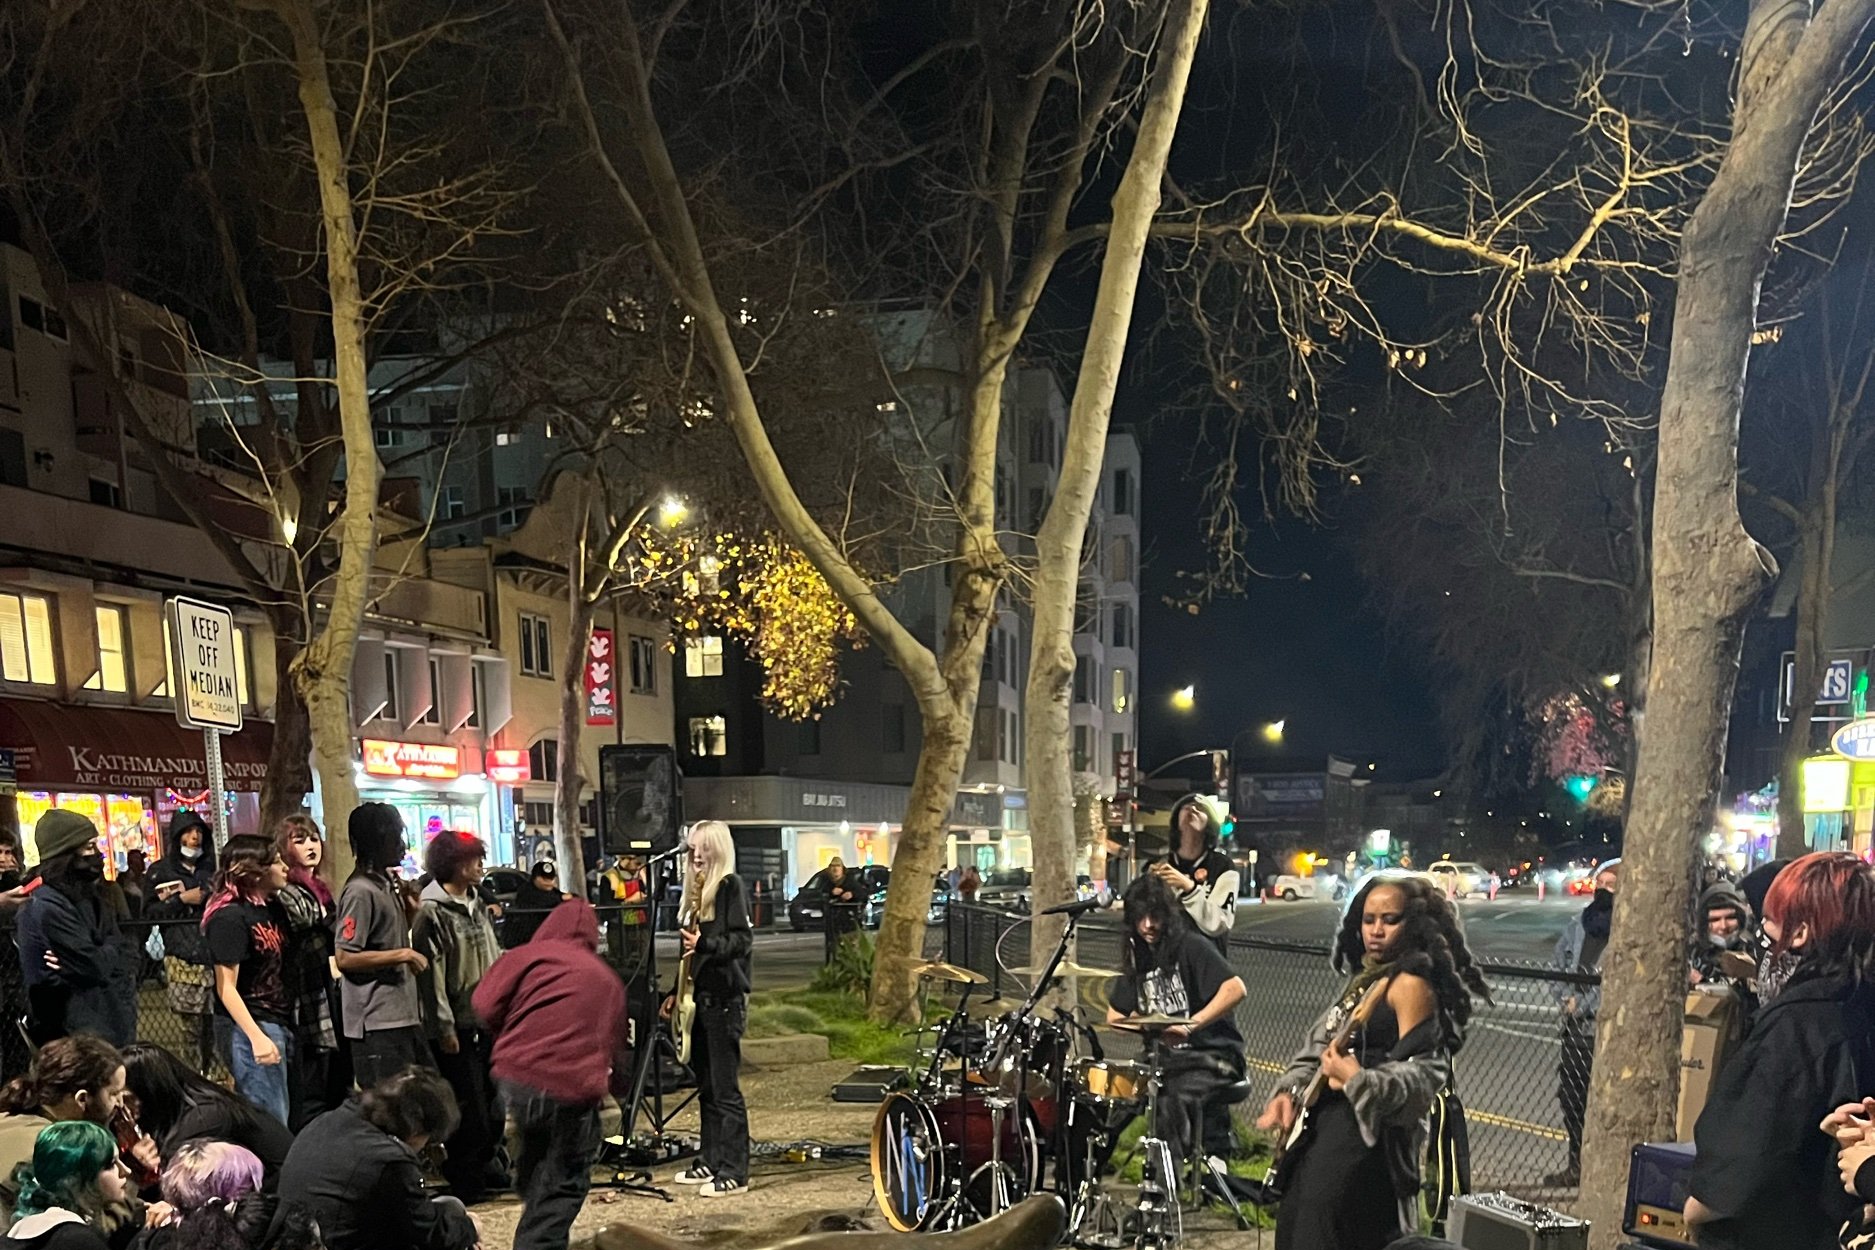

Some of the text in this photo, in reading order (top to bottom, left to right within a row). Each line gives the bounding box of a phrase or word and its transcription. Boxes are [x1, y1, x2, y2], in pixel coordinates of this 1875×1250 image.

[191, 616, 220, 642] KEEP
[198, 644, 219, 668] OFF
[190, 669, 233, 698] MEDIAN
[68, 746, 206, 774] KATHMANDU
[75, 772, 100, 784] ART
[109, 774, 164, 787] CLOTHING
